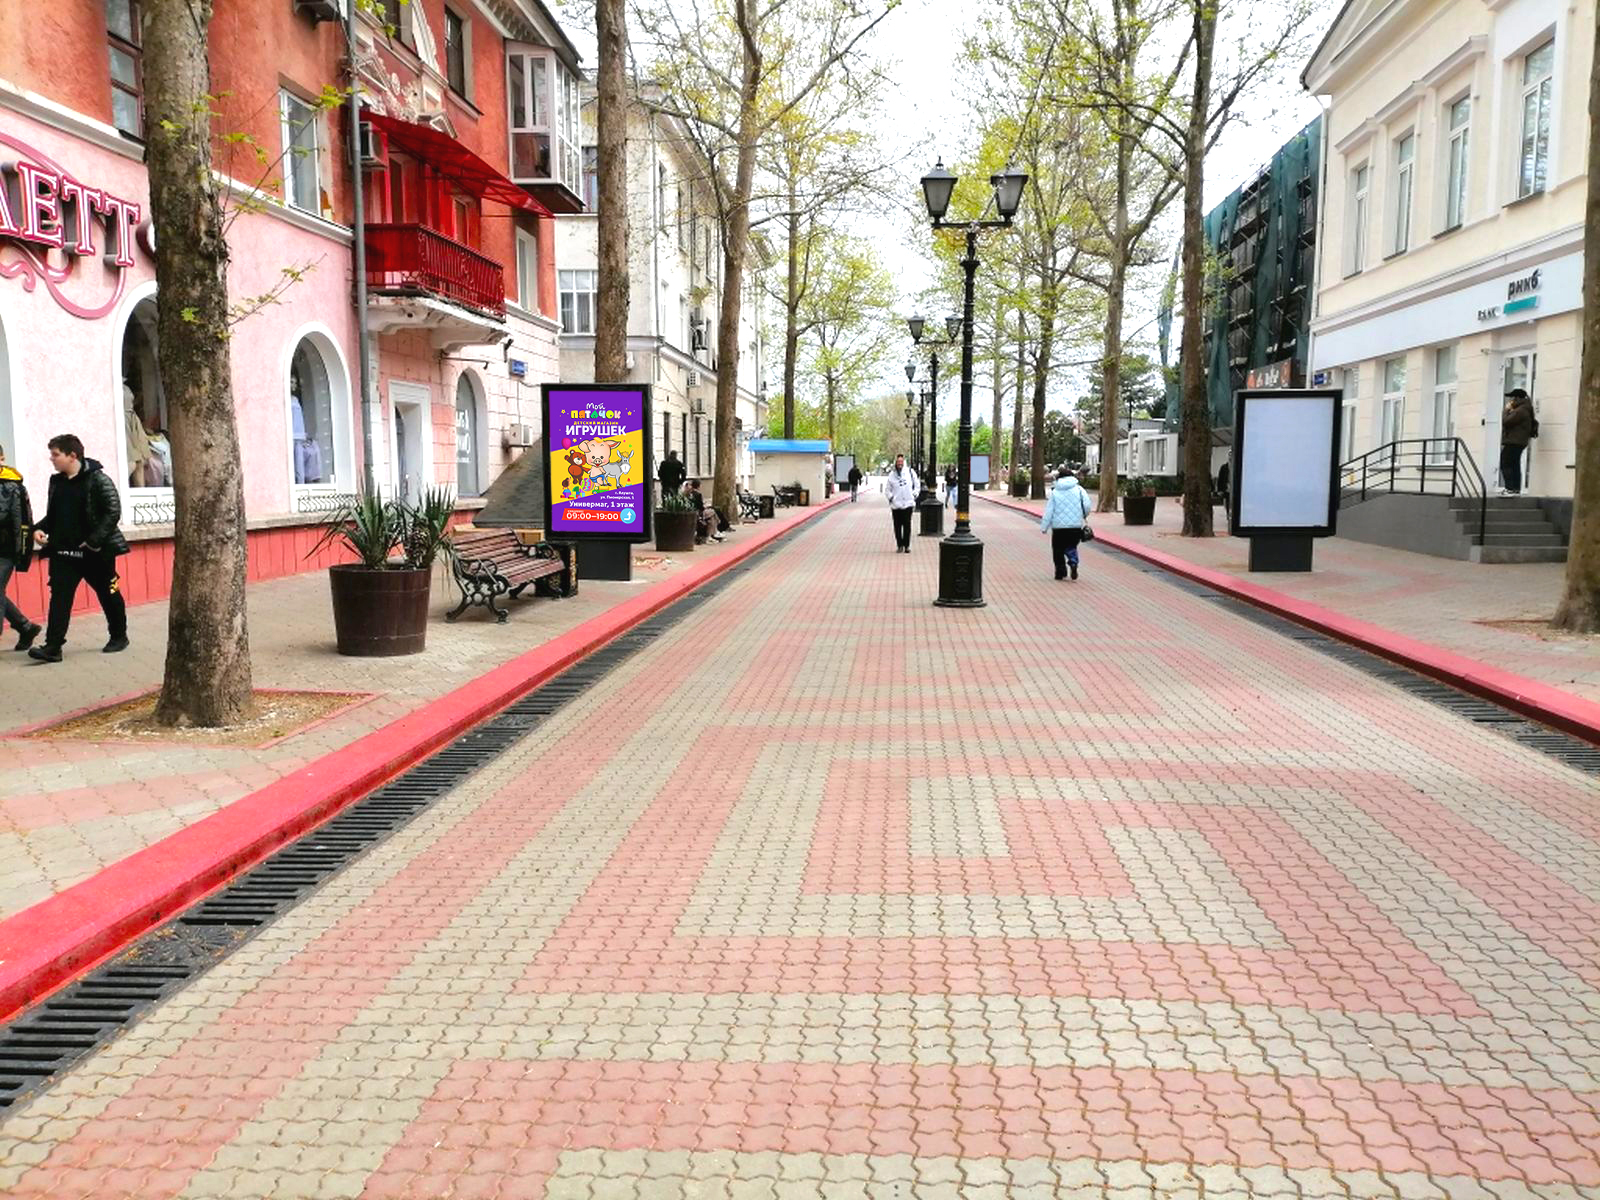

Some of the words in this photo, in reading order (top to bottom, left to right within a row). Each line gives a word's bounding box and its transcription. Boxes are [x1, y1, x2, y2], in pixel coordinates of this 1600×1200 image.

[586, 402, 606, 410] Мой
[565, 425, 627, 436] ИГРУШЕК
[569, 500, 610, 508] Универмаг,
